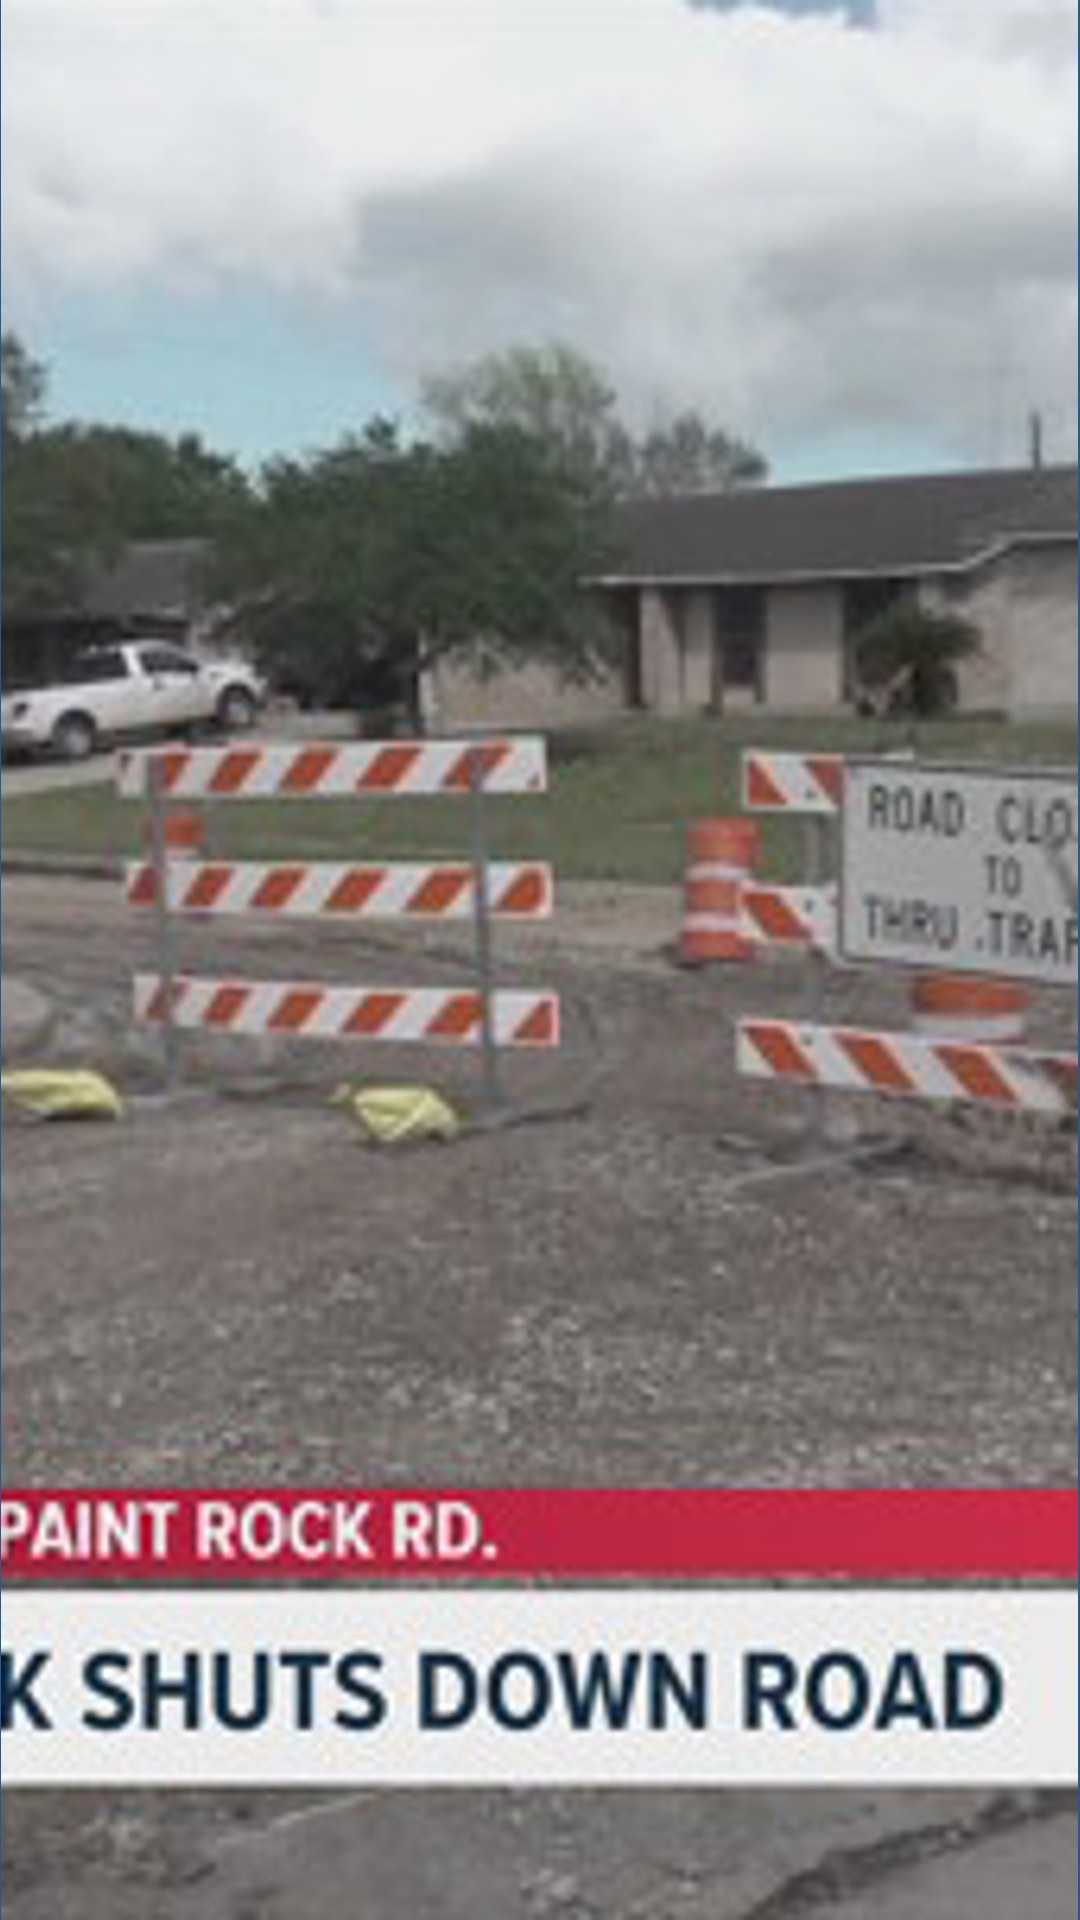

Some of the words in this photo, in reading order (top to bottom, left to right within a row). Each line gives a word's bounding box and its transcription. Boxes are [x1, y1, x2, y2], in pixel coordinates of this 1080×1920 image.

[867, 785, 965, 837] ROAD
[985, 855, 1021, 897] TO
[864, 896, 958, 950] THRU
